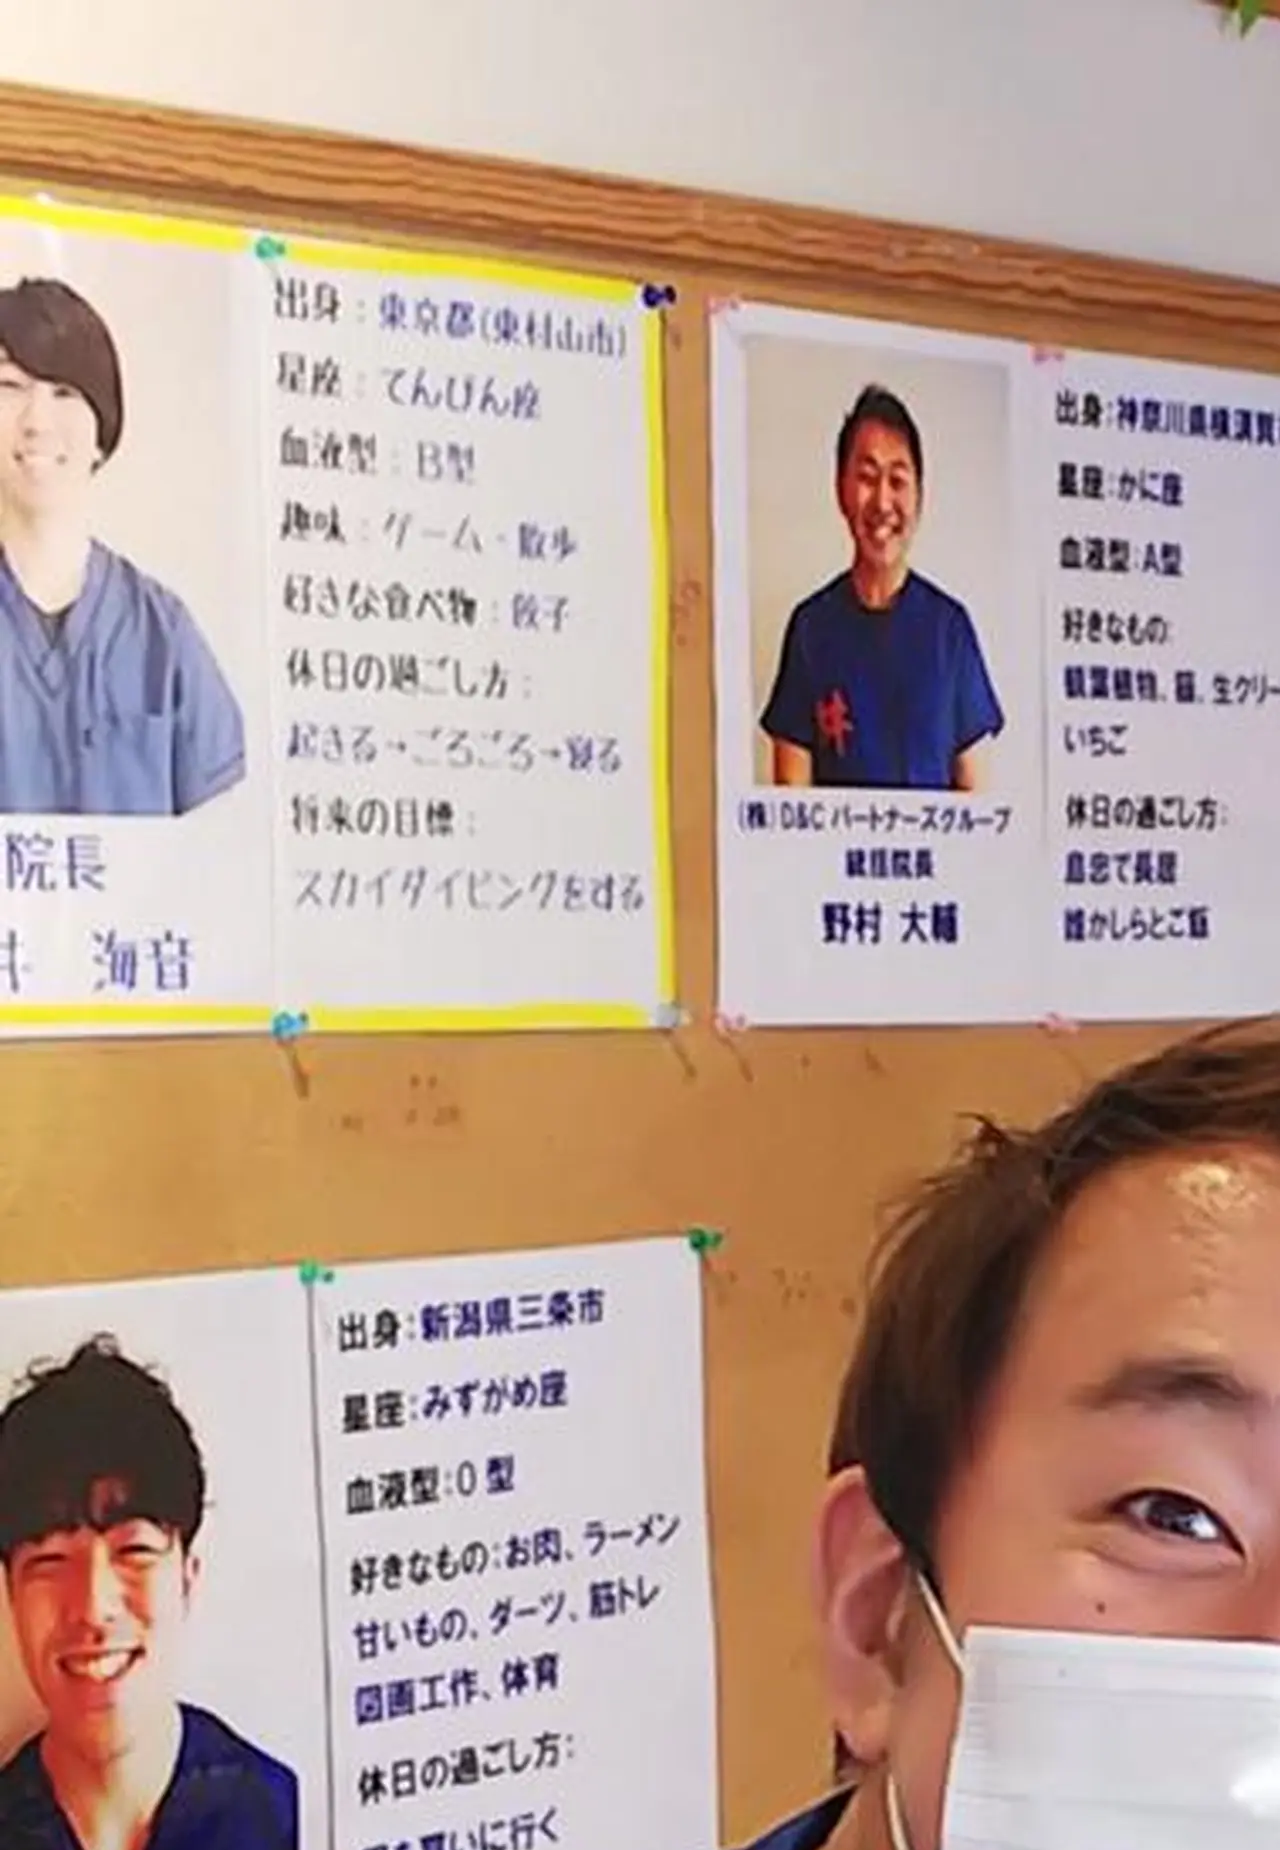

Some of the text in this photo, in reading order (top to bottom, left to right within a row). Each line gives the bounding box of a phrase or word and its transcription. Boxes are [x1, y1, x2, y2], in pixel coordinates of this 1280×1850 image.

[1064, 724, 1129, 758] いちご
[5, 831, 107, 892] 院長
[822, 902, 882, 945] 野村
